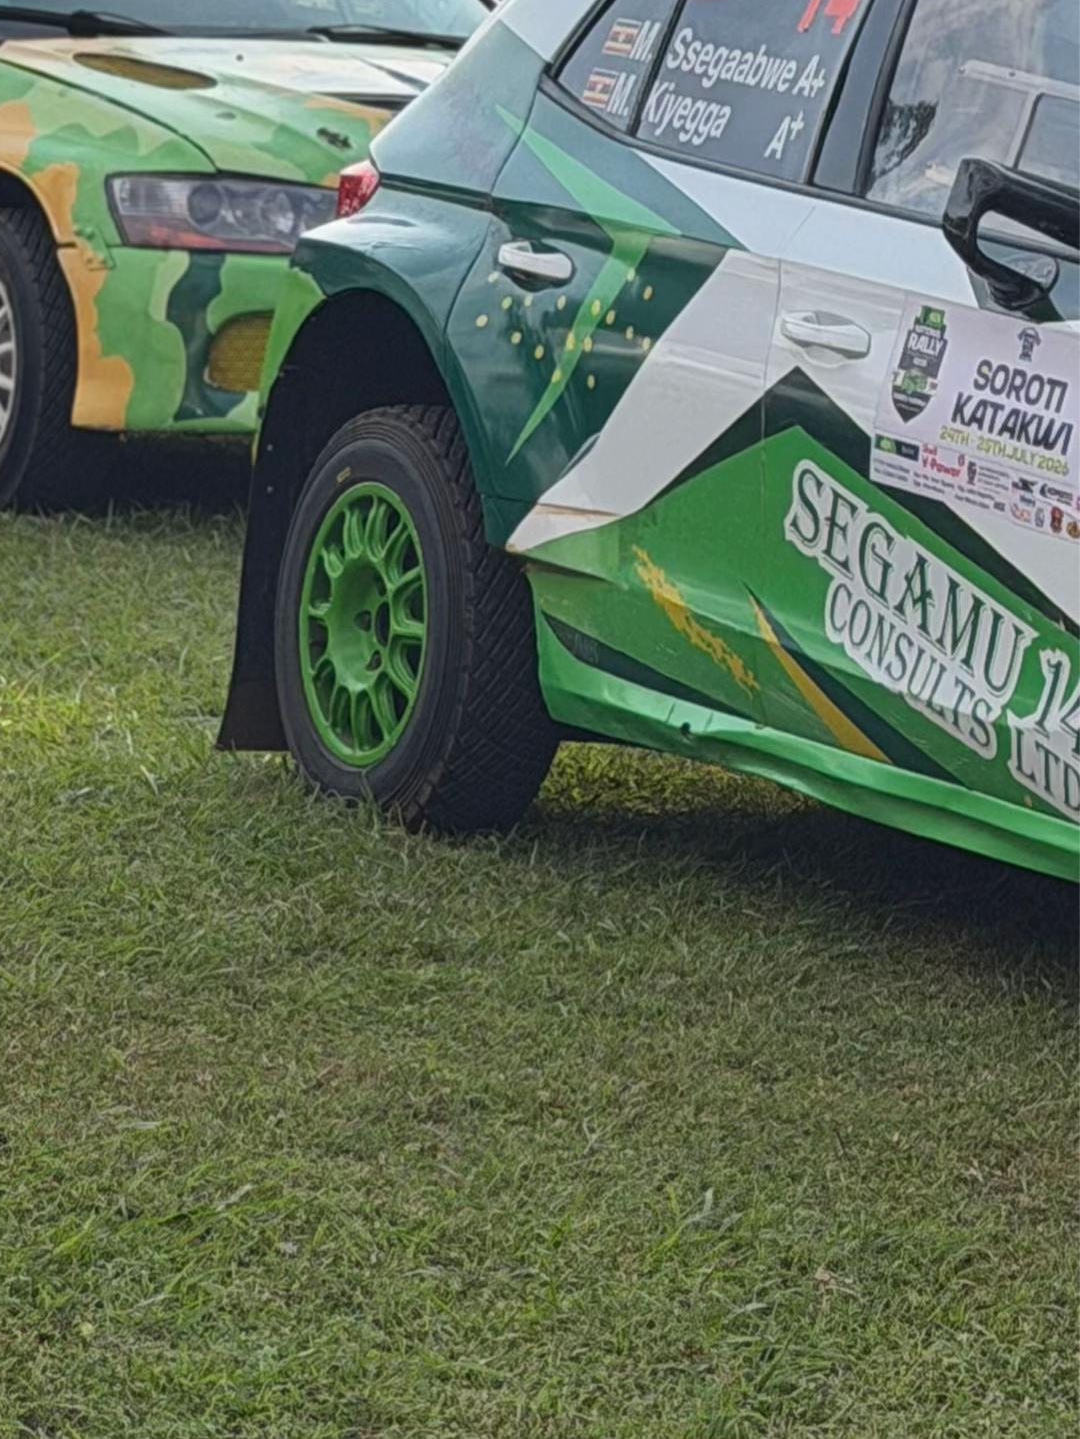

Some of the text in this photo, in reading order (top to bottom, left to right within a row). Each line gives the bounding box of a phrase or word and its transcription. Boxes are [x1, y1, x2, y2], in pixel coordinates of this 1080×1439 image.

[629, 19, 825, 98] M. Ssegaabwe A+
[607, 72, 805, 160] M. Kiyegga A+
[907, 332, 944, 355] RALLY
[973, 359, 1069, 413] SOROTI
[951, 392, 1074, 456] KATAKWI
[1006, 444, 1039, 466] JULY
[790, 468, 1029, 699] SEGAMU
[830, 583, 995, 751] CONSULTS
